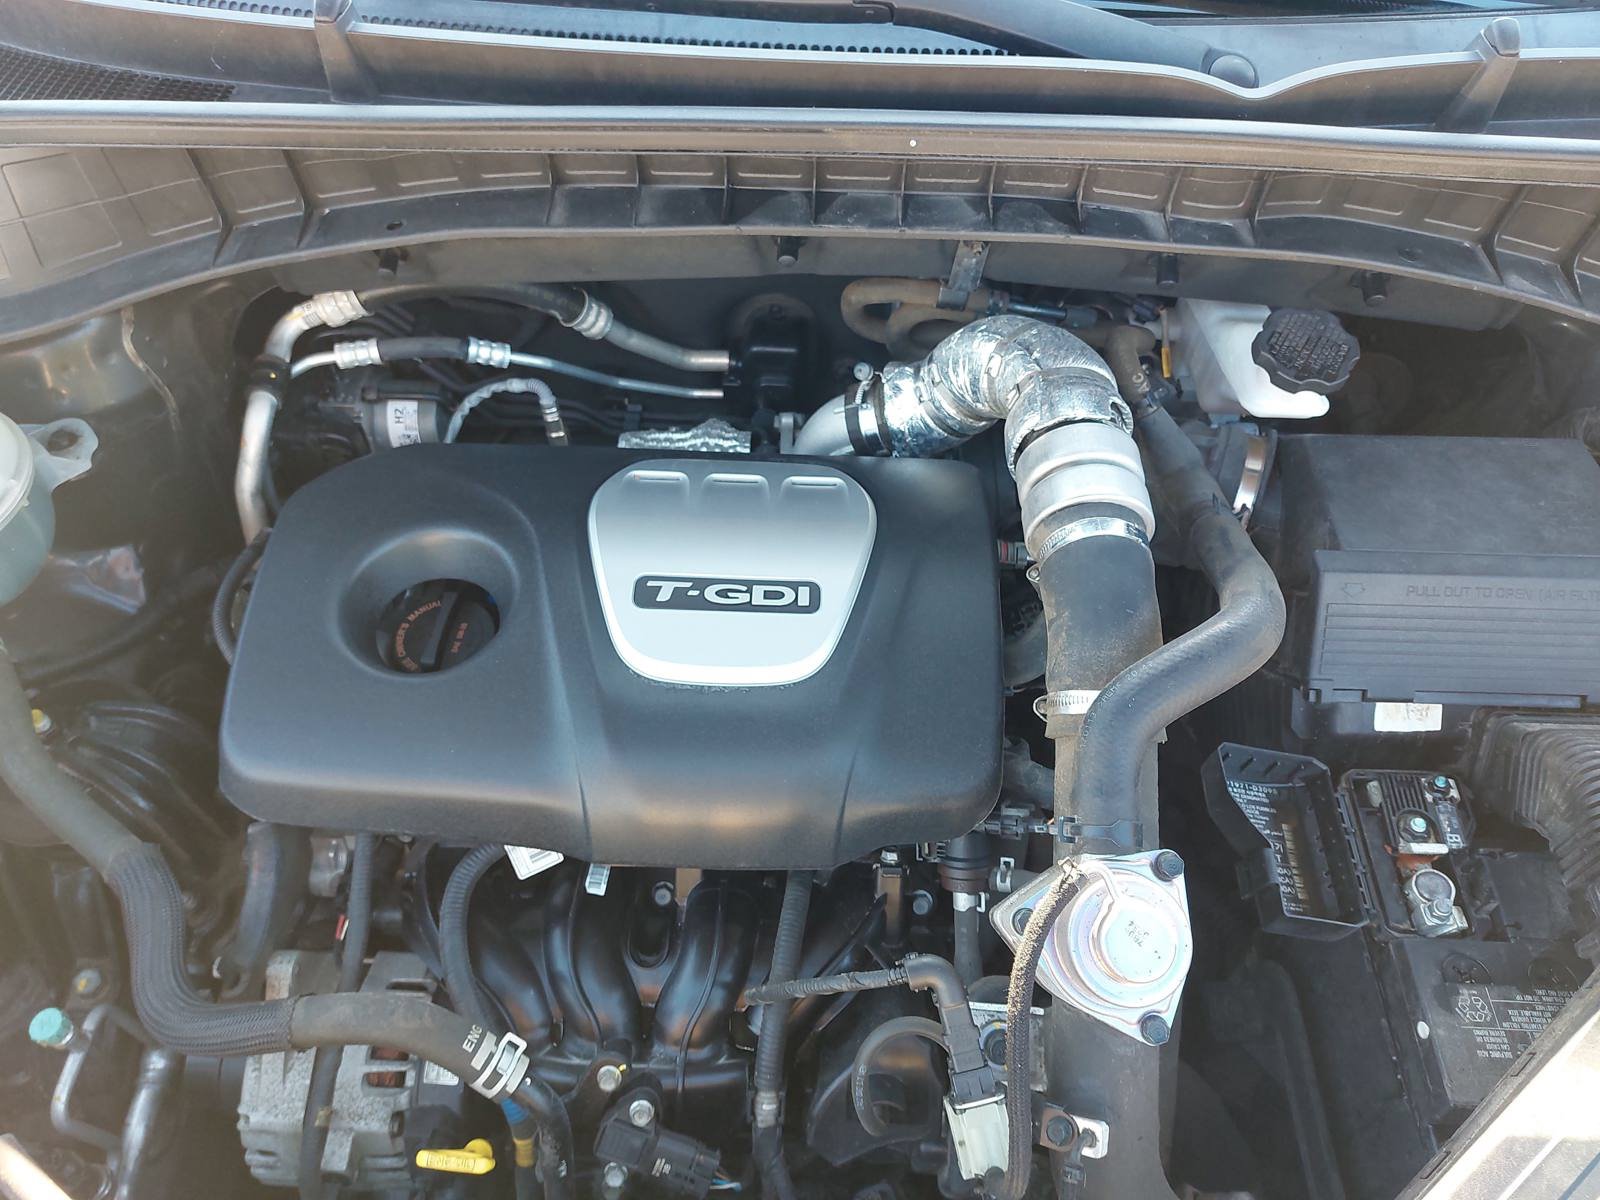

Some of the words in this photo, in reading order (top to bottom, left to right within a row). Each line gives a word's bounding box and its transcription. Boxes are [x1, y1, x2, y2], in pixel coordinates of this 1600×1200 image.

[646, 580, 811, 606] T-GDI
[1406, 584, 1441, 597] PULL
[1443, 586, 1471, 598] OUT
[1475, 586, 1493, 599] TO
[1495, 587, 1532, 601] OPEN
[408, 600, 441, 621] MANUAL
[462, 1024, 482, 1053] ENG
[1477, 1050, 1489, 1058] ACID
[1489, 1050, 1513, 1059] SULFURIC
